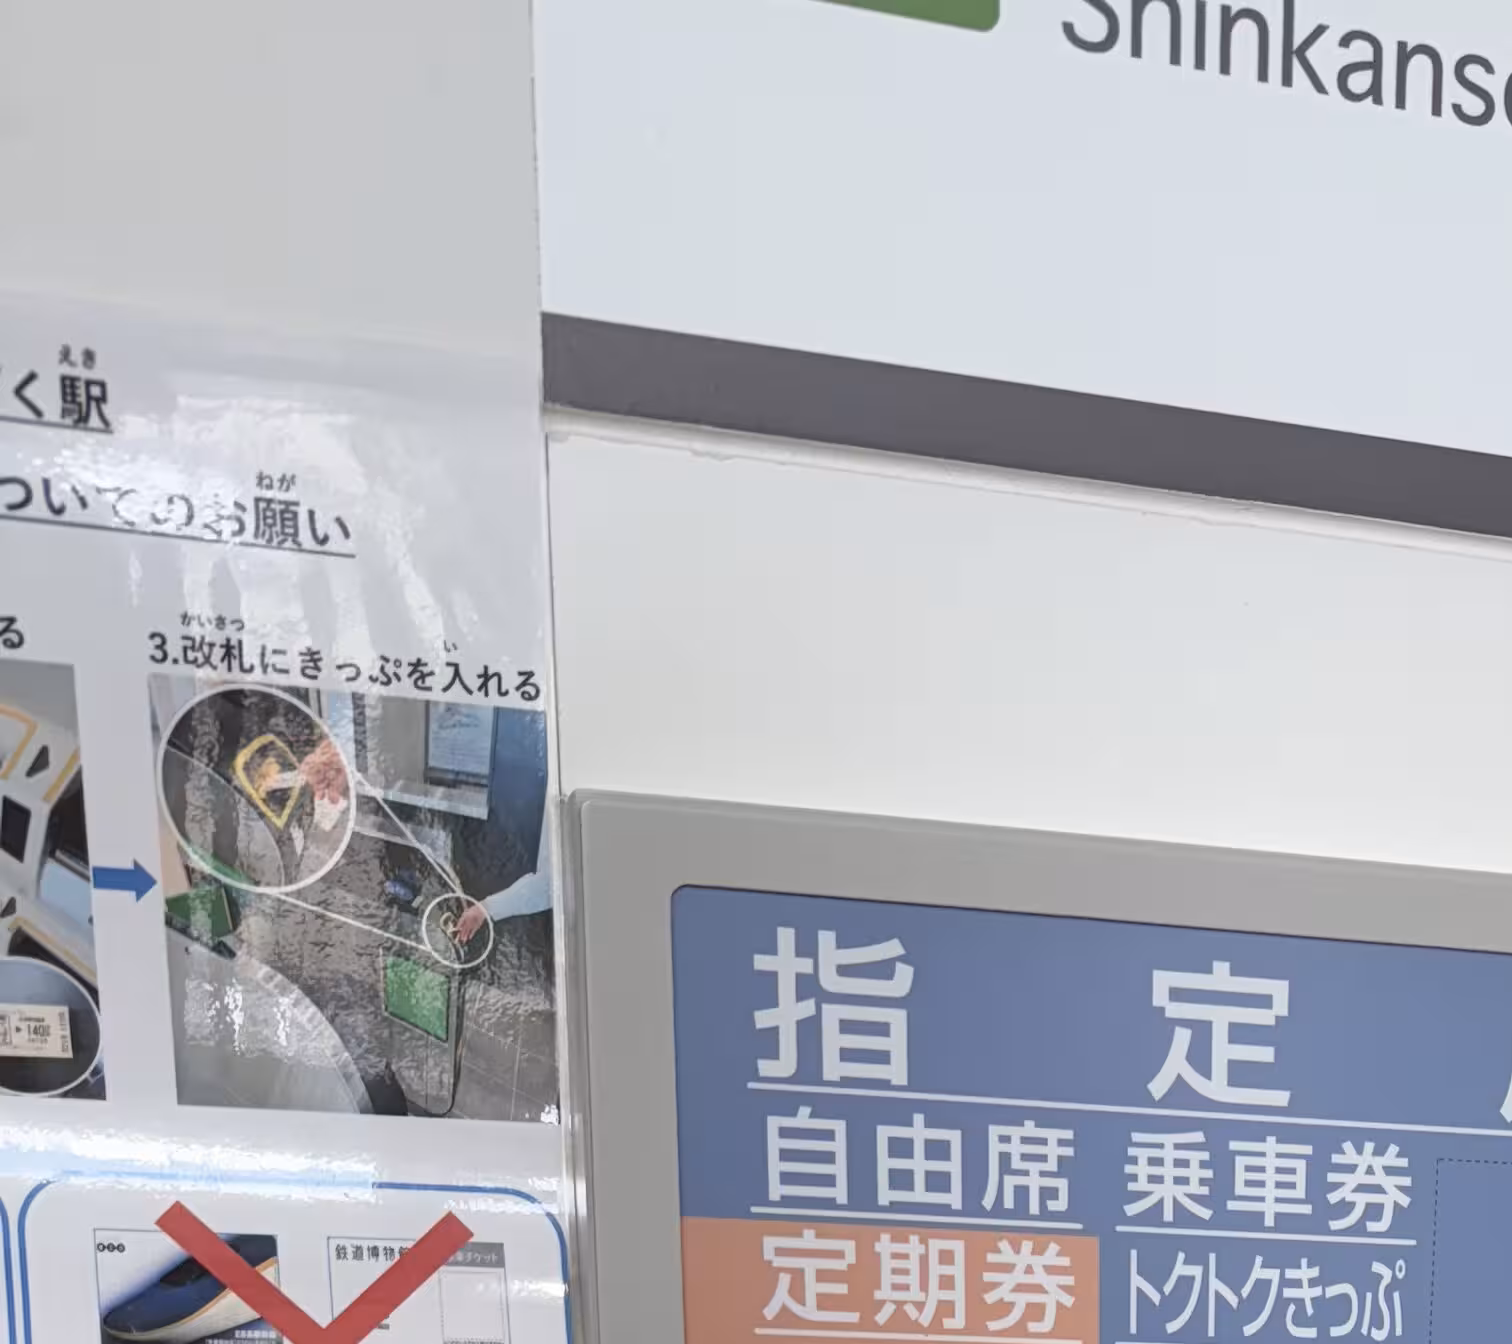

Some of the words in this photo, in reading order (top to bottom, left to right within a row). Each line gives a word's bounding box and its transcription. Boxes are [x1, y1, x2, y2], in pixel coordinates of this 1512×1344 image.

[766, 1106, 1075, 1216] 自由席
[1123, 1130, 1412, 1234] 乗車券
[762, 1229, 1076, 1333] 定期券
[1128, 1248, 1406, 1342] トクトクきっぷ
